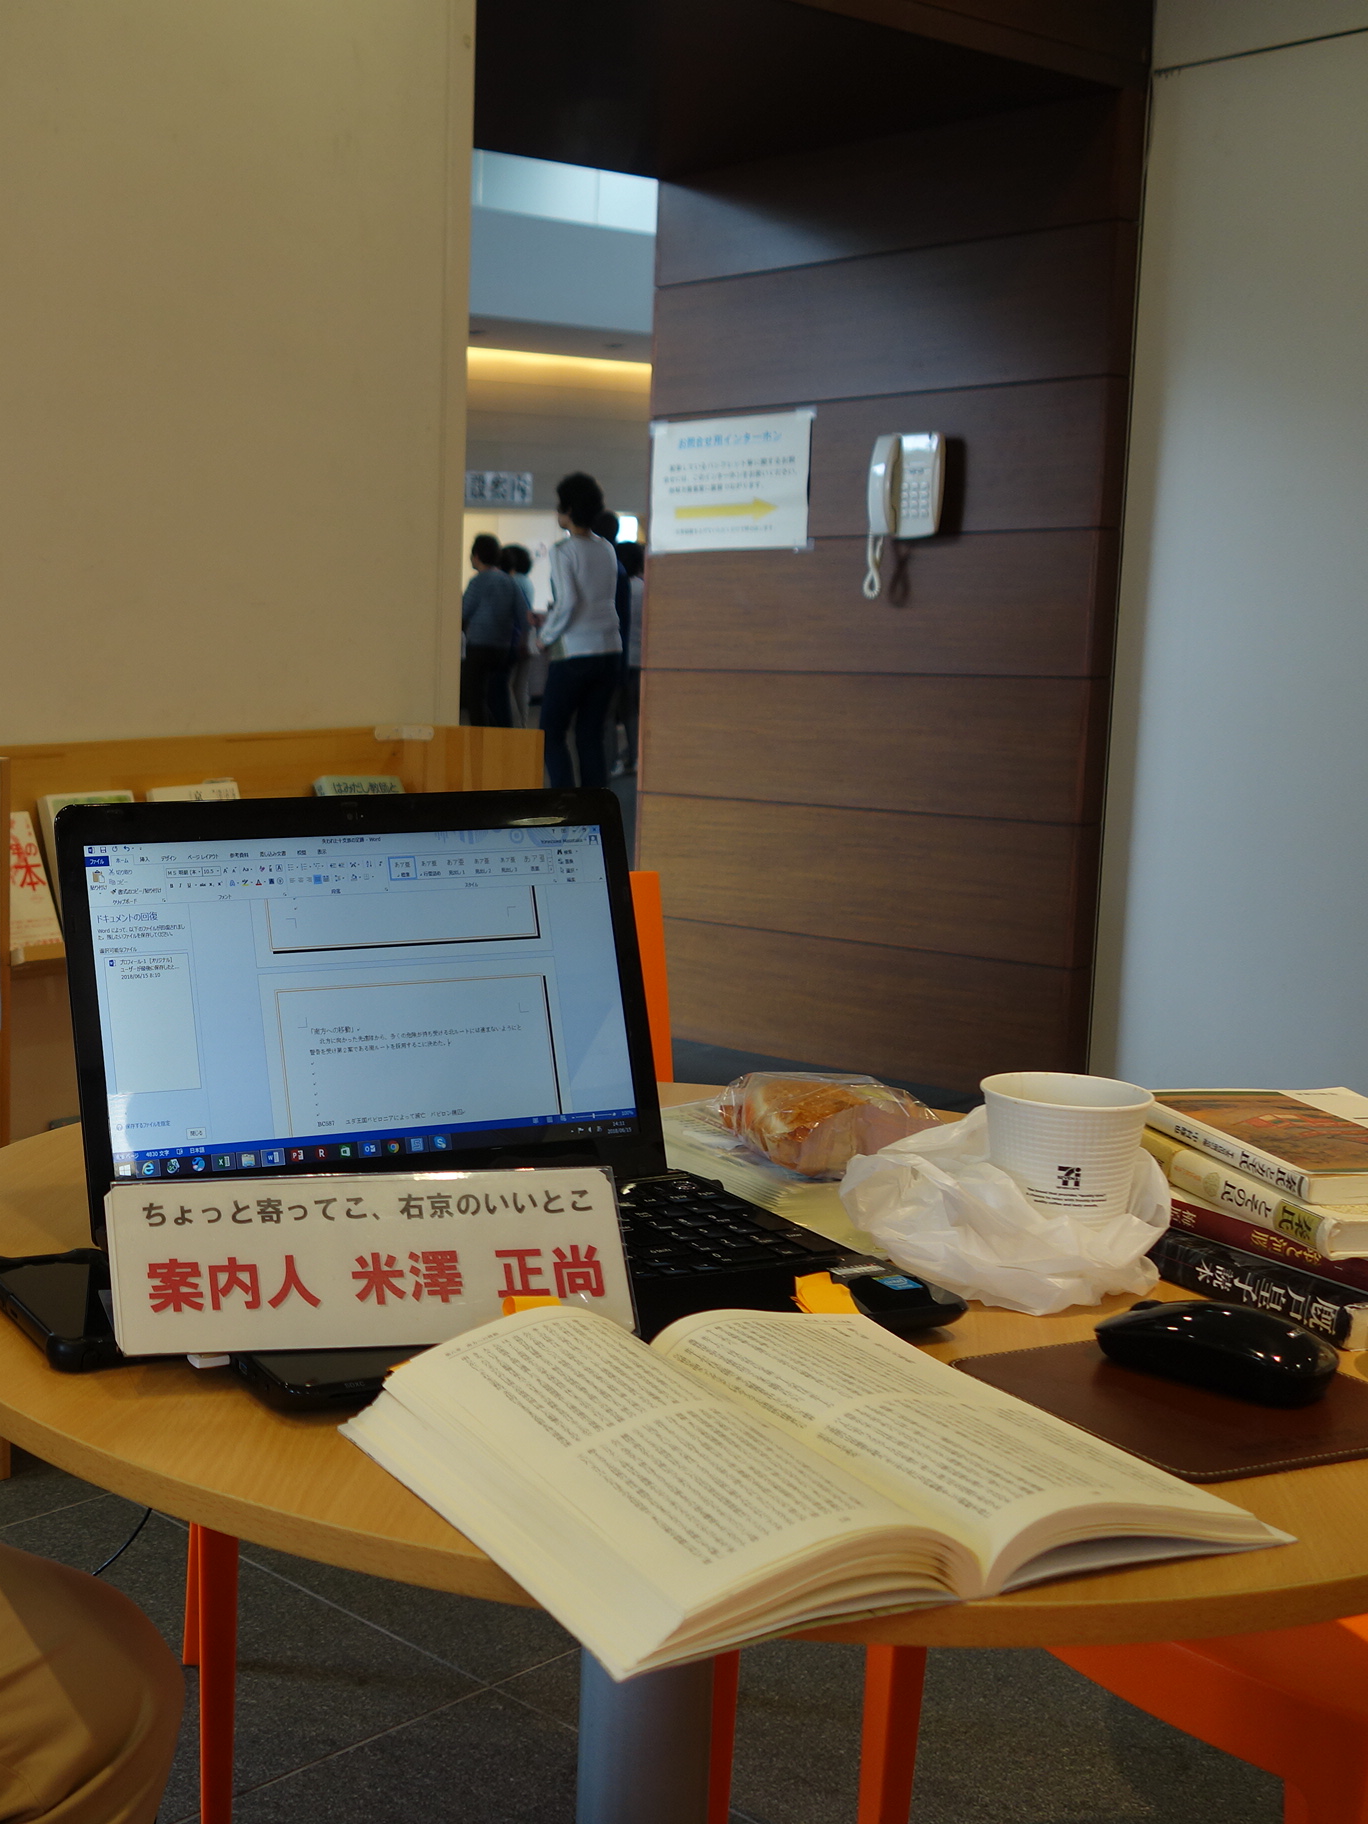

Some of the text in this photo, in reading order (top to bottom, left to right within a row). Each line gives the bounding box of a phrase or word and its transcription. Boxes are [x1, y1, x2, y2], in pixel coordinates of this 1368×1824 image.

[97, 911, 158, 923] ドキュメントの回復
[142, 1189, 594, 1227] ちょっと寄ってこ、右京のいいとこ
[147, 1244, 607, 1313] 案内人 米澤 正尚
[1195, 1258, 1340, 1336] 厩戸皇子読本
